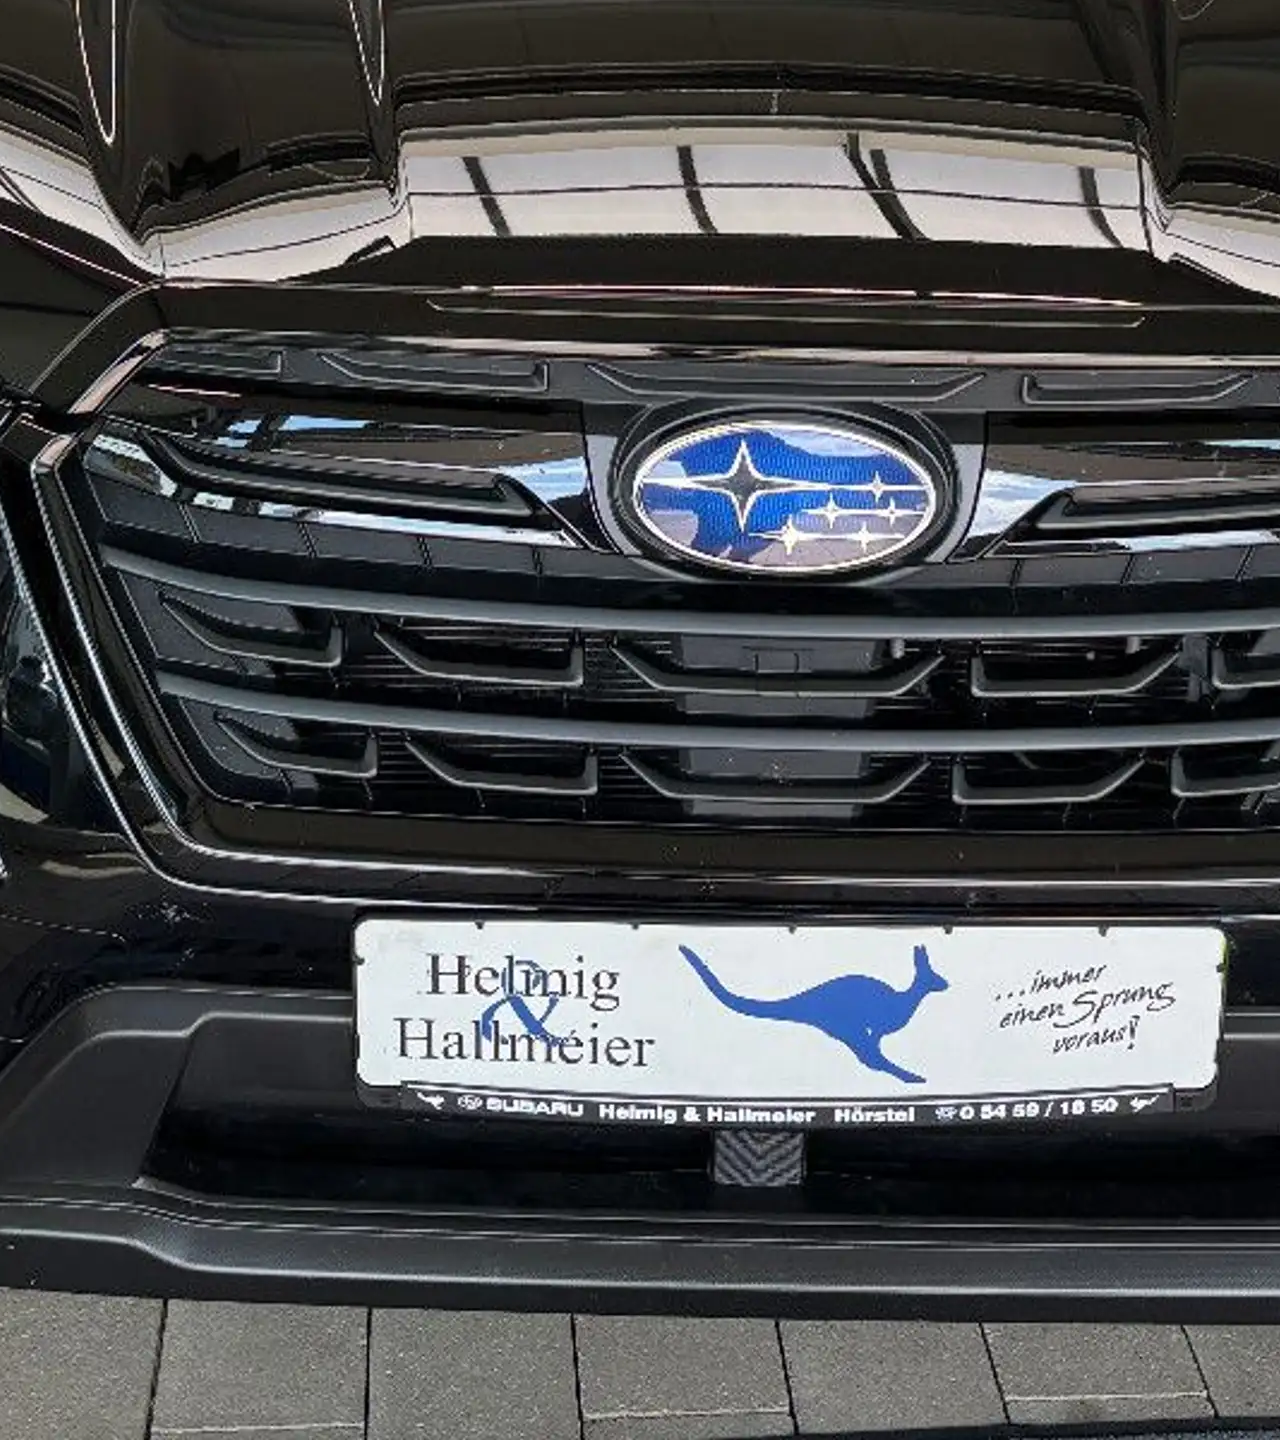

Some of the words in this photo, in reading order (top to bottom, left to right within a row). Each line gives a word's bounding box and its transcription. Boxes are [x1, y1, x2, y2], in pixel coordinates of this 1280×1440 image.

[425, 953, 620, 1012] Helmig
[999, 1003, 1066, 1029] einen
[1052, 982, 1177, 1029] Sprung
[393, 1017, 656, 1067] Hallmeier
[1052, 1014, 1141, 1054] voraus!
[486, 1097, 584, 1117] SUBARU
[599, 1104, 677, 1125] Helmig
[684, 1106, 702, 1123] &
[707, 1106, 816, 1124] Hallmeier
[834, 1105, 915, 1122] Hörstel
